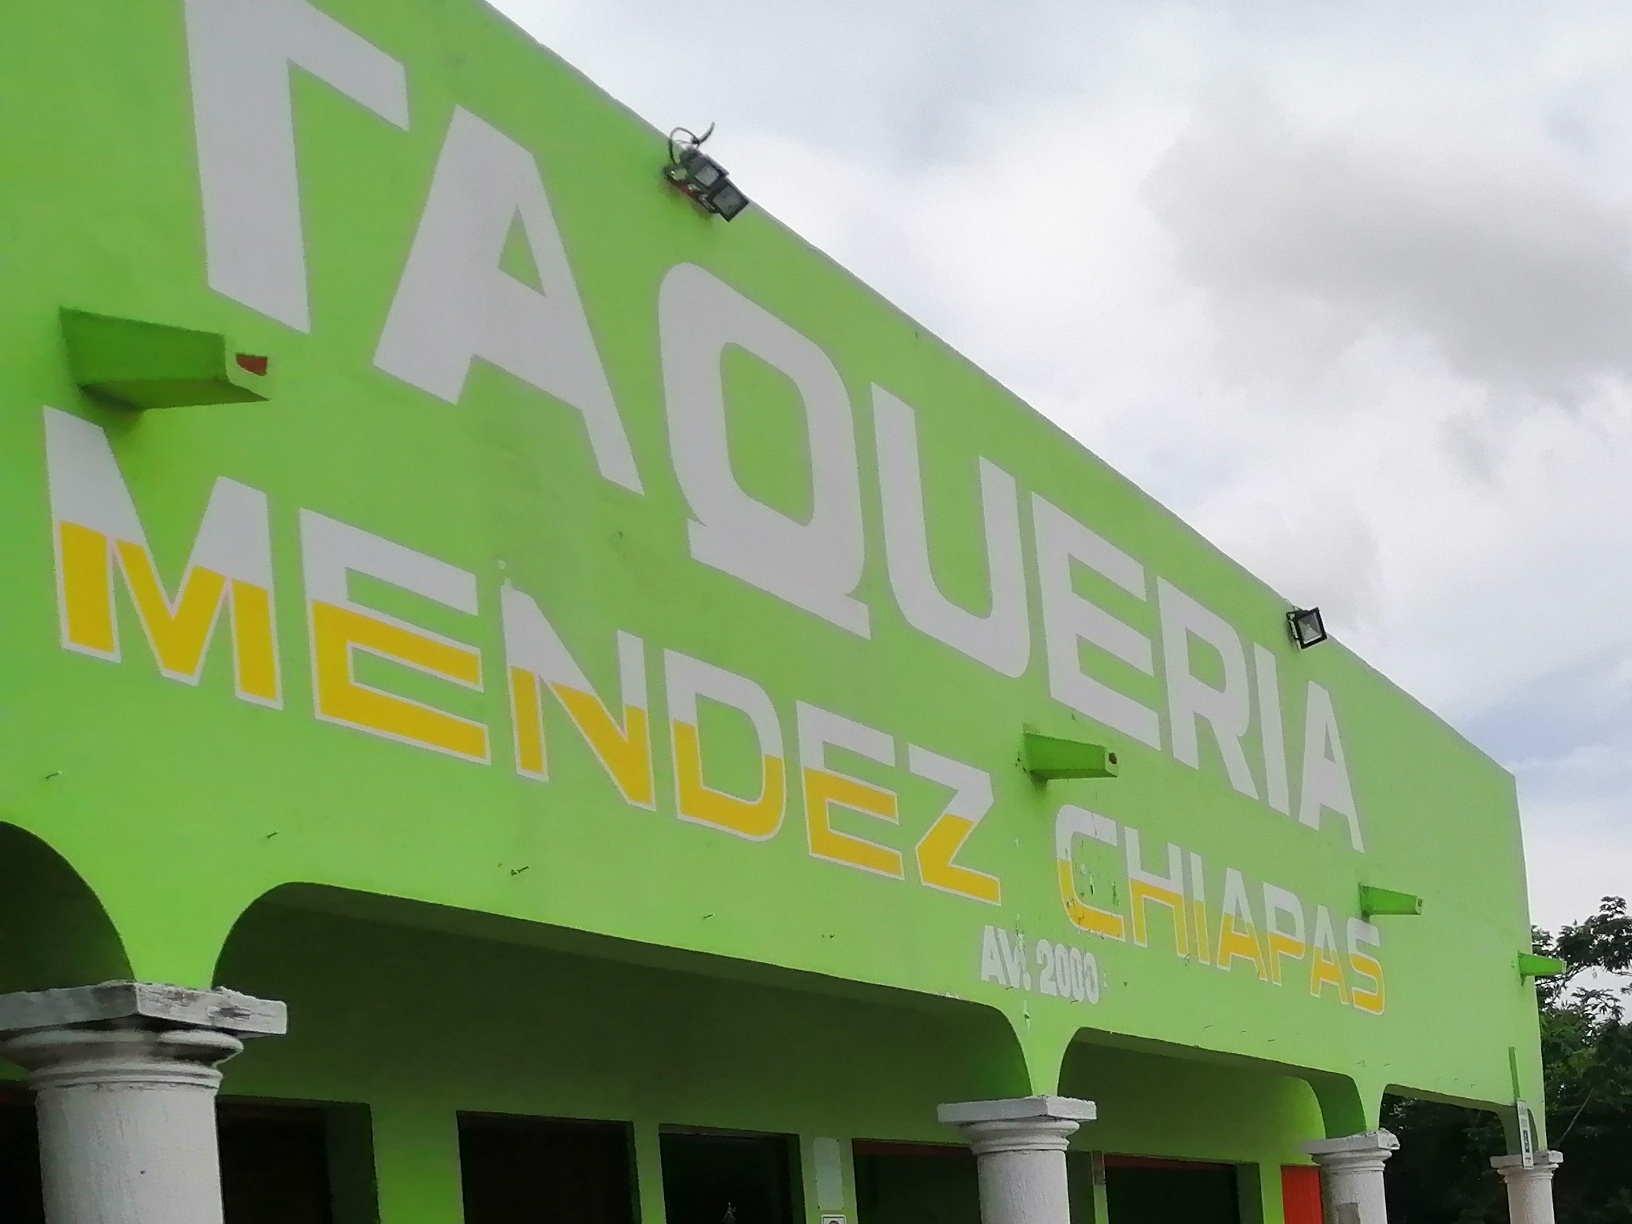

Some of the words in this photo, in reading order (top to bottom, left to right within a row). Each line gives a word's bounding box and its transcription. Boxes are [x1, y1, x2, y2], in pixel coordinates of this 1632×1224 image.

[43, 405, 1001, 906] MENDEZ
[1055, 803, 1384, 1016] CHIAPAS
[184, 0, 1365, 853] TAQUERIA
[981, 925, 1031, 991] AV.
[1036, 938, 1100, 1004] 2000
